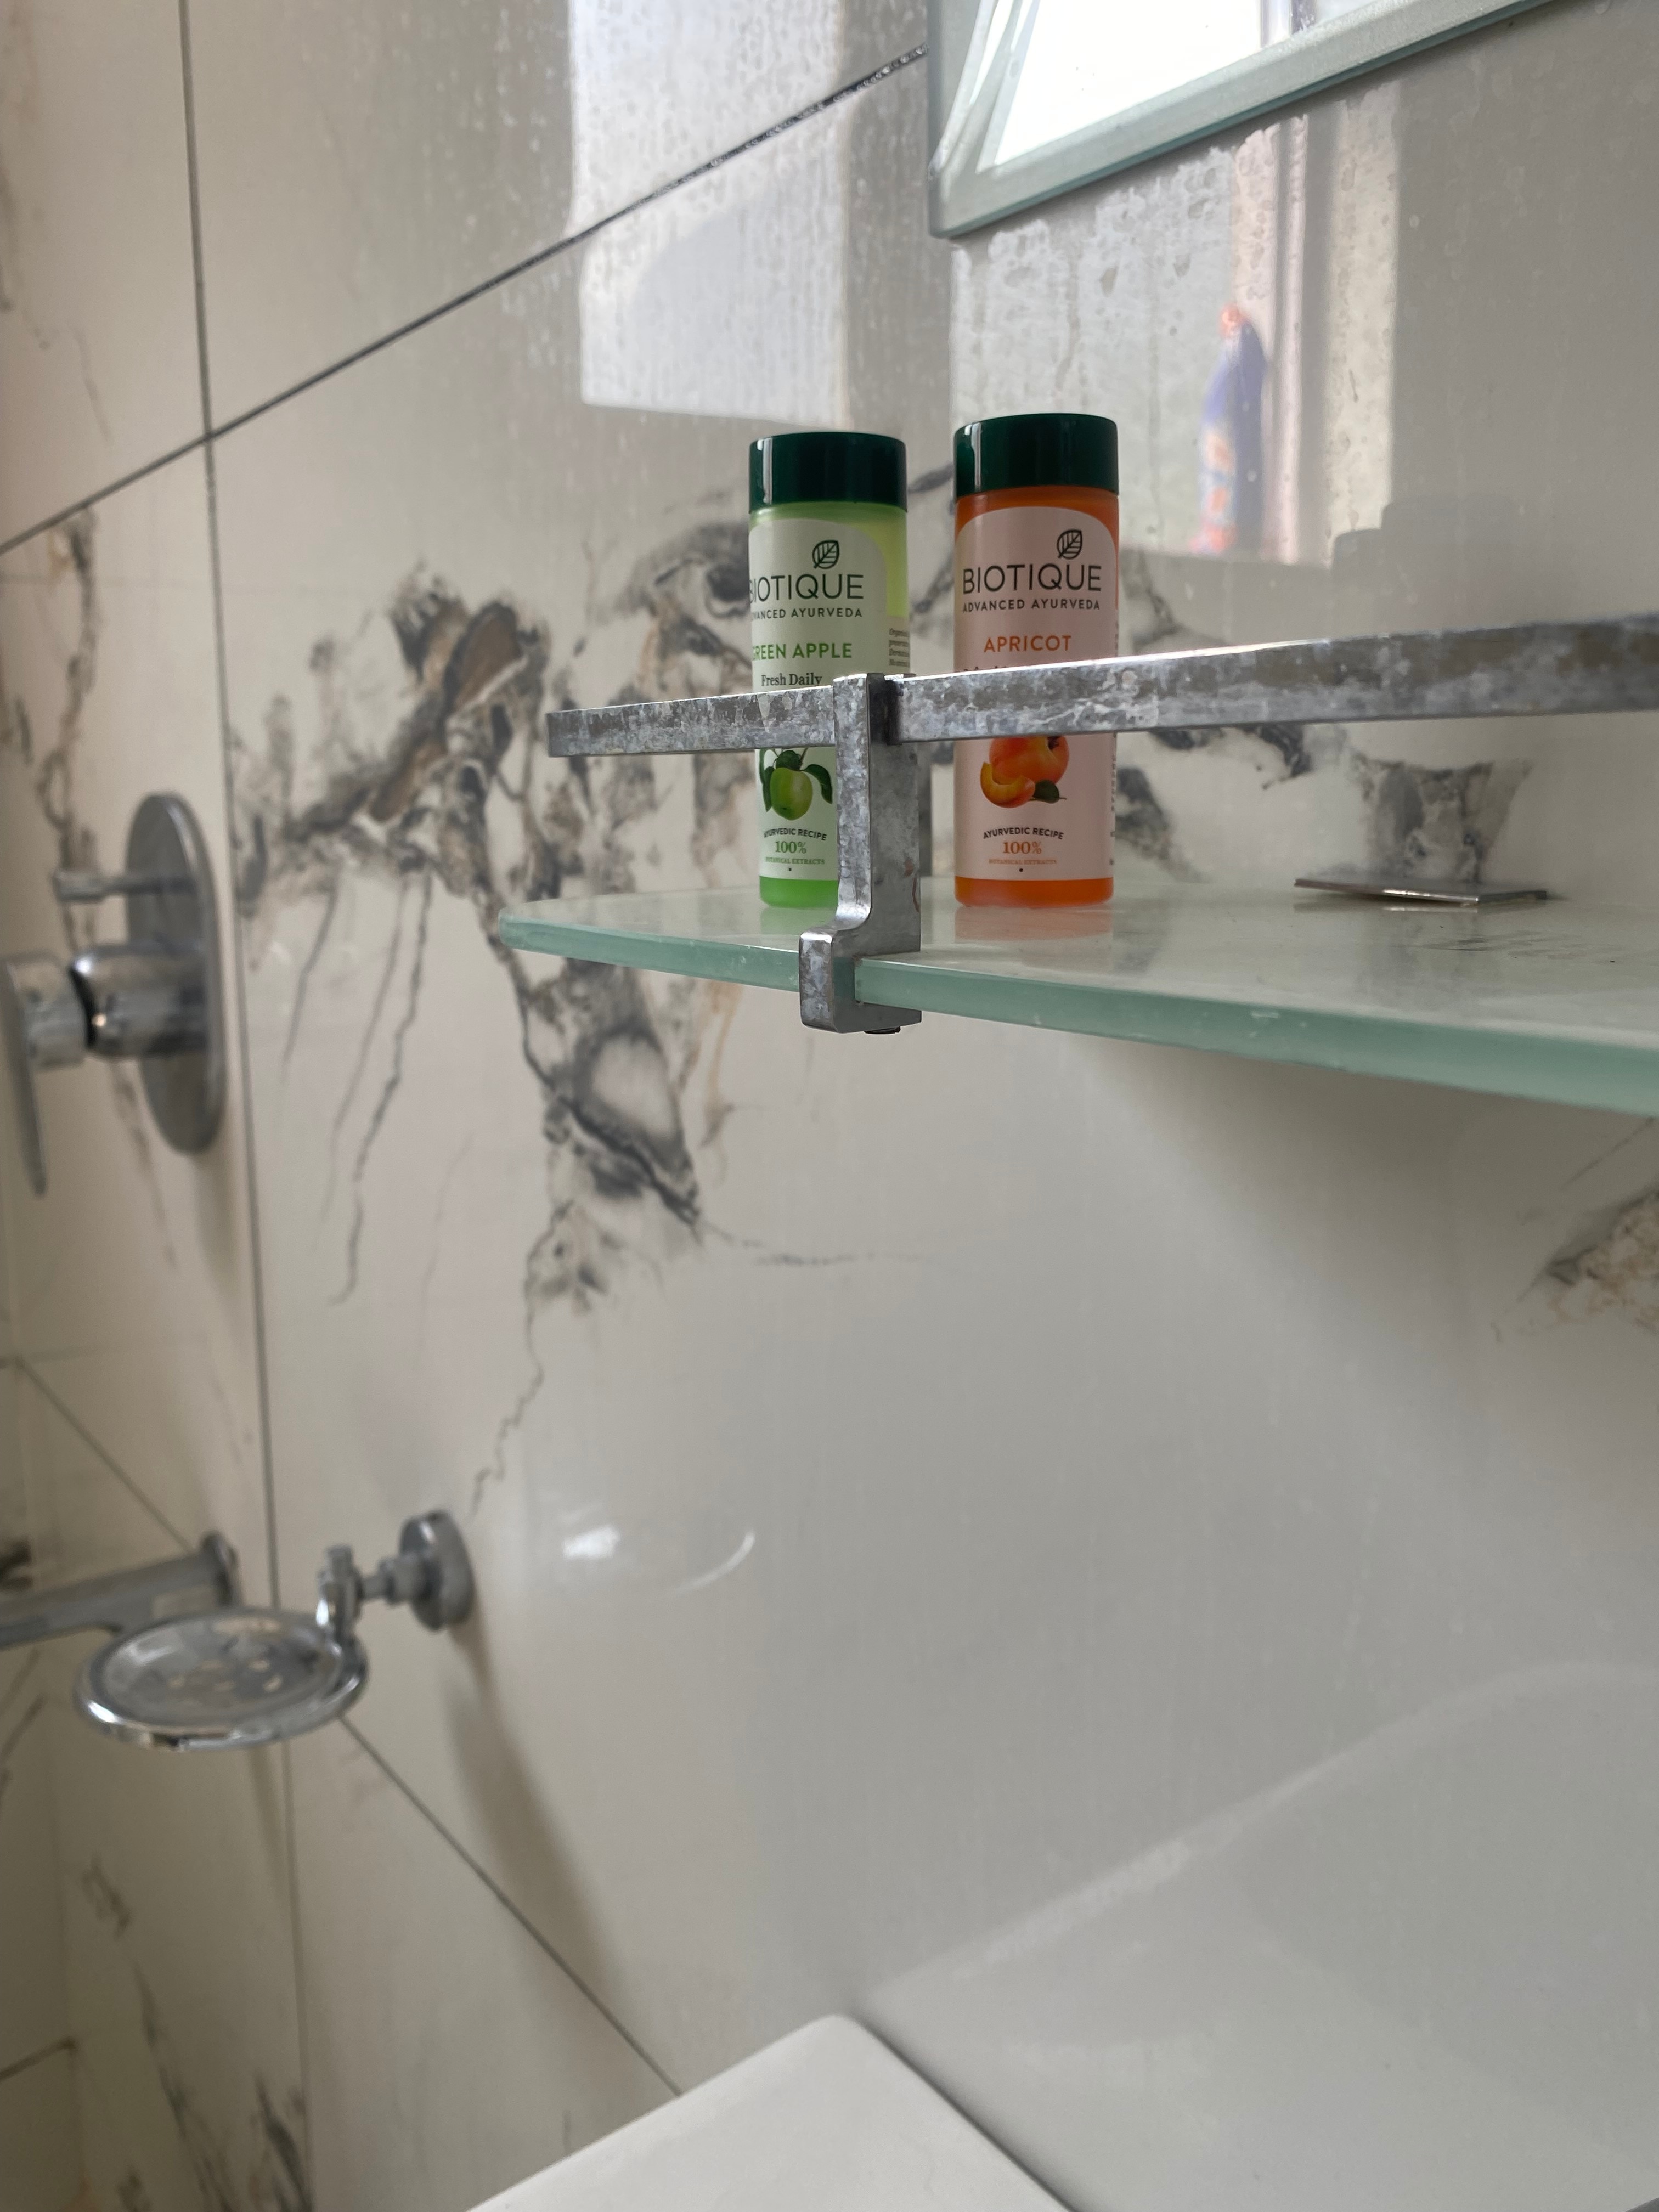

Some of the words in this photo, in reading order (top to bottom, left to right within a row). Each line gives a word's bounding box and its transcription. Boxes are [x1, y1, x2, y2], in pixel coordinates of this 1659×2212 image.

[963, 563, 1102, 594] BIOTIQUE
[791, 608, 863, 618] AYURVEDA
[962, 599, 1025, 613] ADVANCED
[1031, 599, 1101, 611] AYURVEDA
[792, 642, 853, 658] APPLE
[984, 635, 1071, 653] APRICOT
[761, 673, 786, 686] Fresh
[789, 672, 823, 687] Daily
[798, 828, 827, 841] RECIPE
[983, 827, 1030, 839] AYURVEDIC
[1032, 827, 1064, 840] RECIPE
[775, 840, 806, 854] 100%
[1002, 841, 1042, 854] 100%
